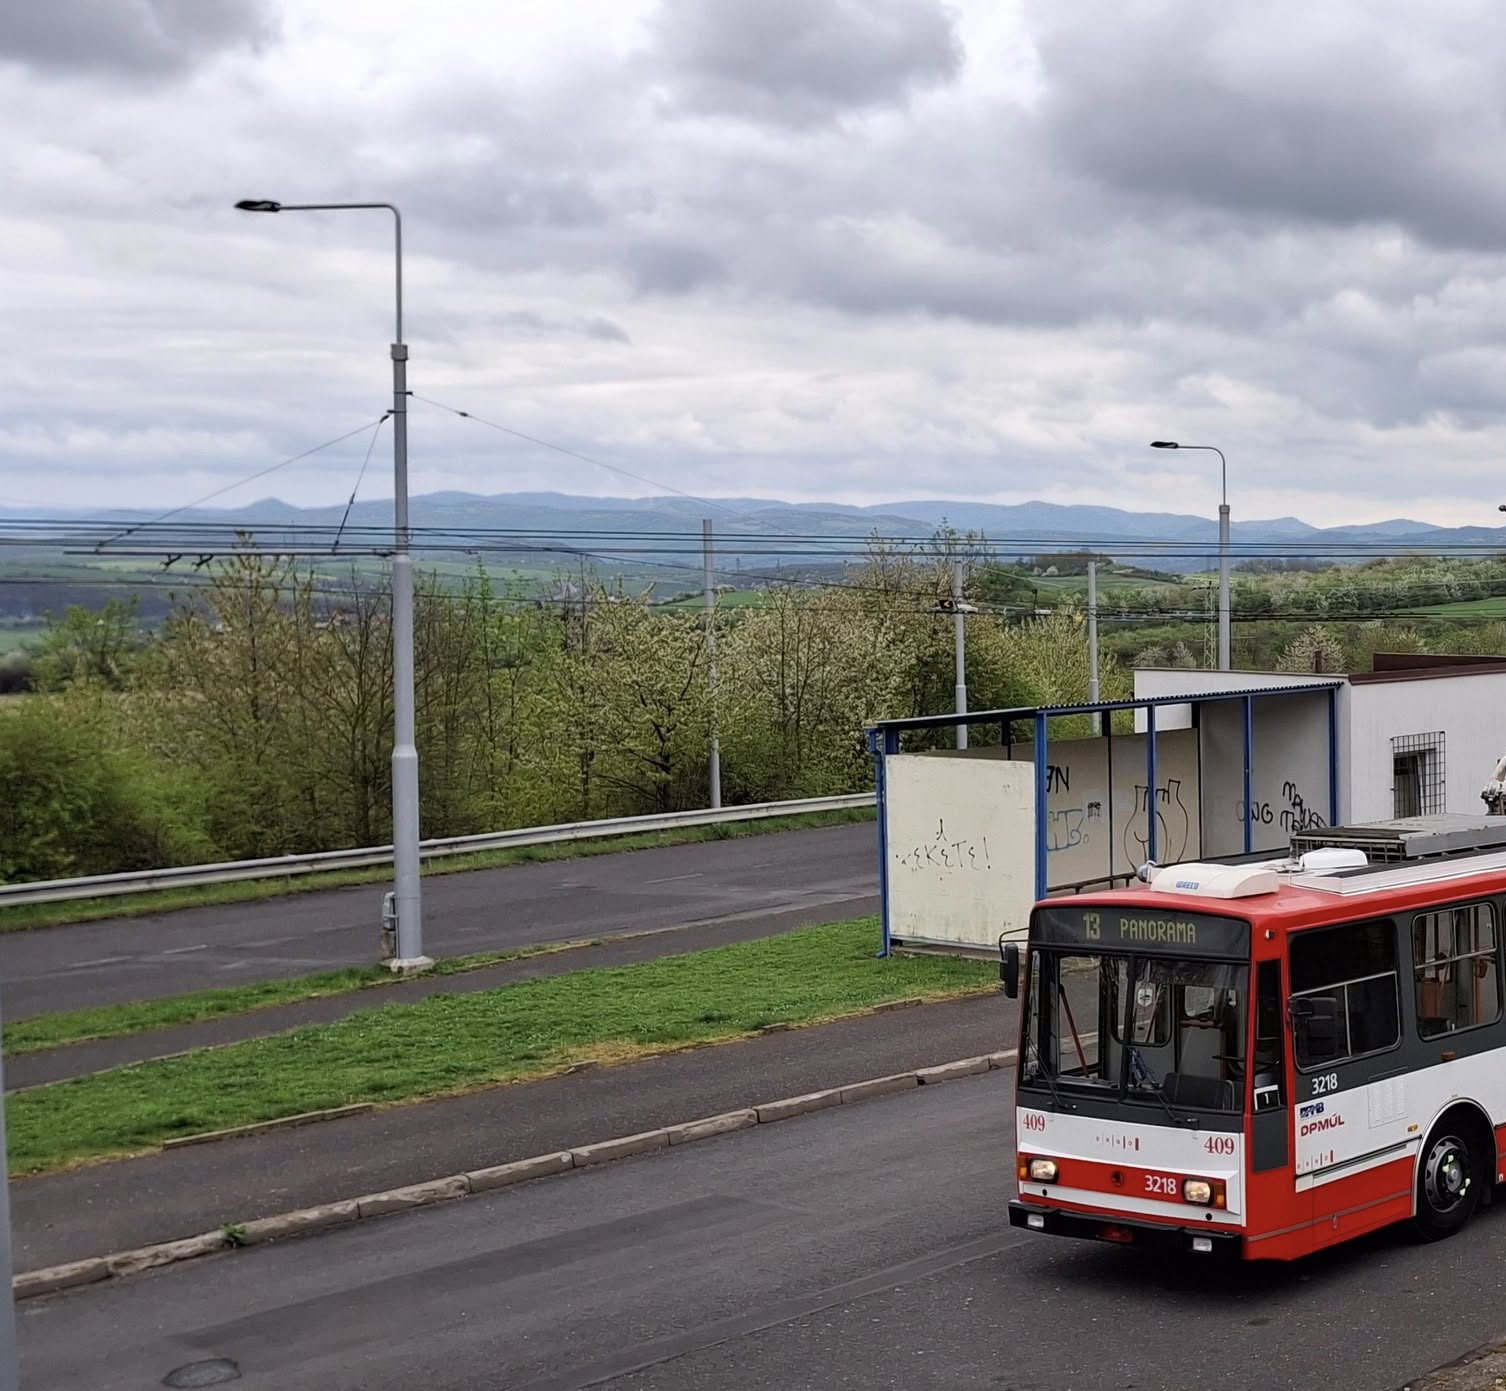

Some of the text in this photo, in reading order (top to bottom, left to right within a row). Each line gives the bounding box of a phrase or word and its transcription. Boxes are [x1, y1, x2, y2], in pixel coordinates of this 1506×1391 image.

[1083, 911, 1196, 944] 13 PANORAMA
[1311, 1073, 1338, 1095] 3218
[1023, 1113, 1046, 1132] 409
[1300, 1113, 1345, 1137] DPMÚL
[1204, 1135, 1235, 1156] 409
[1144, 1174, 1177, 1195] 3218
